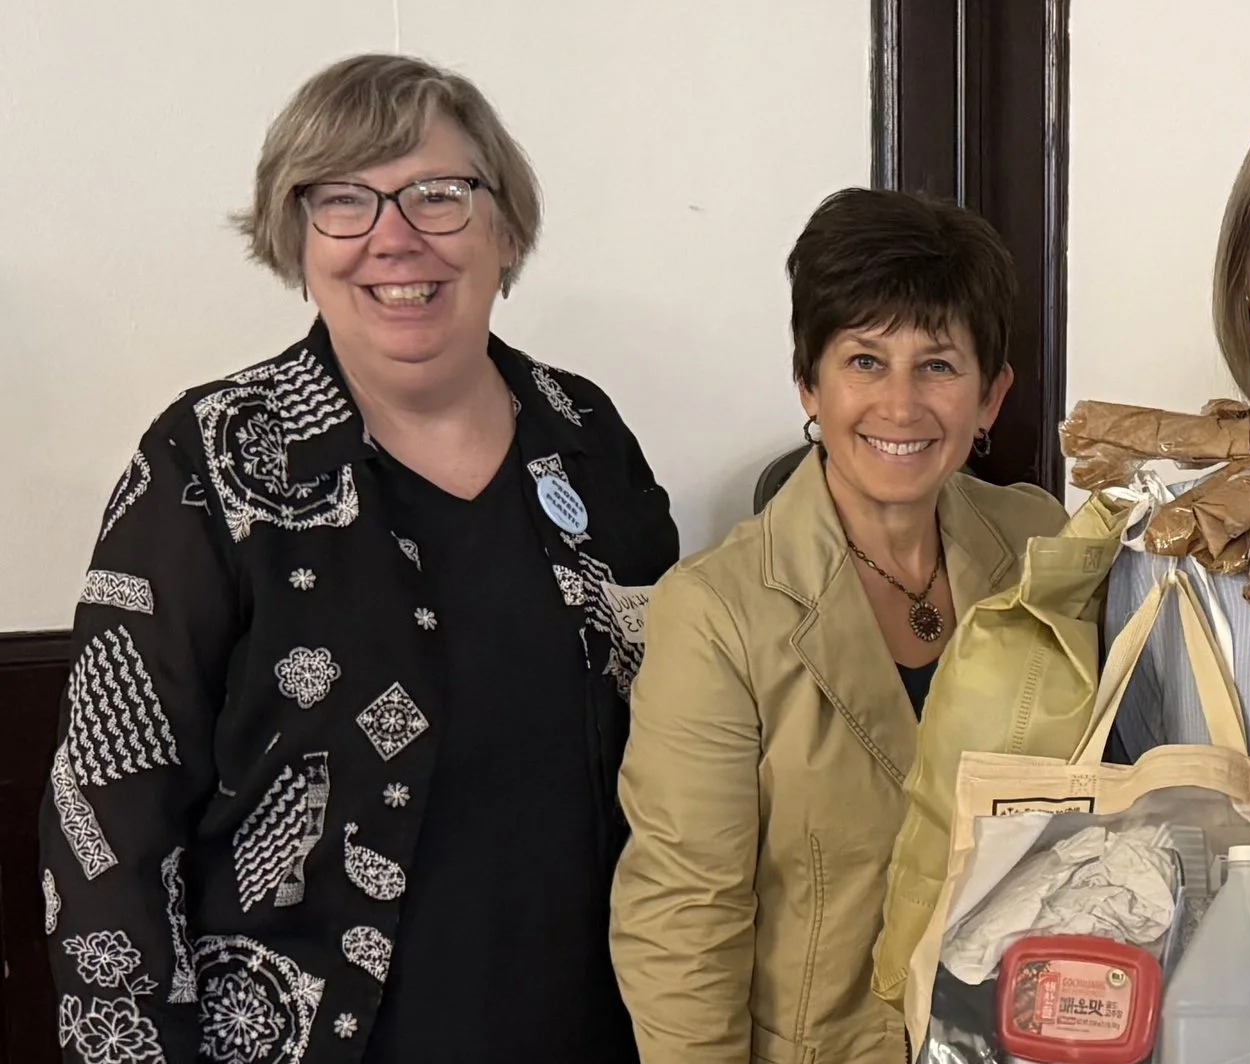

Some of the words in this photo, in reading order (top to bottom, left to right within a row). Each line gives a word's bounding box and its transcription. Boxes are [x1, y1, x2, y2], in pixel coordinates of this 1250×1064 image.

[545, 493, 581, 529] PLASTIC
[553, 490, 579, 516] OVER
[1058, 997, 1104, 1017] 매운맛
